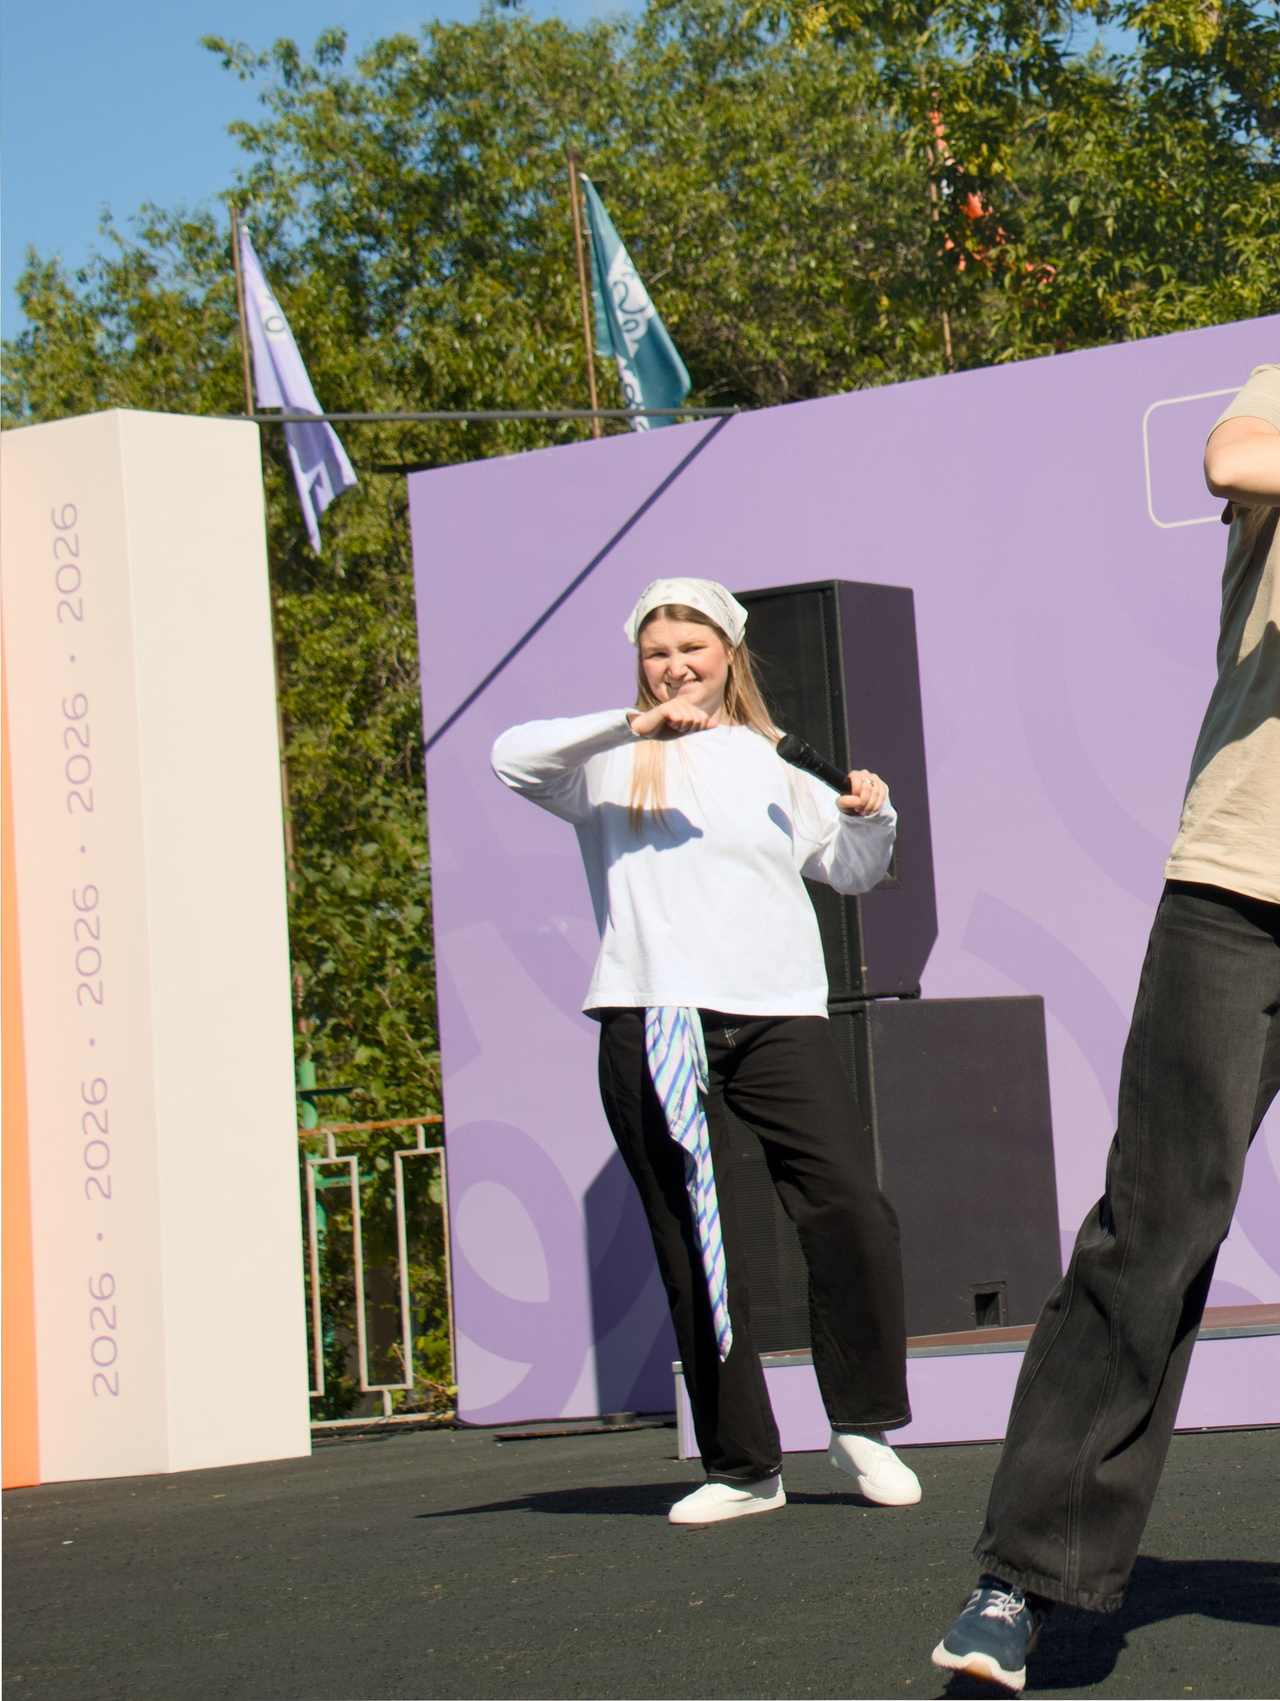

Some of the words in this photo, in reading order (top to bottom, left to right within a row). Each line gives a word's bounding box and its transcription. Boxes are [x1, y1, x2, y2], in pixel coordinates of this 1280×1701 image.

[51, 502, 84, 624] 2026
[62, 692, 95, 815] 2026
[72, 884, 104, 1007] 2026
[81, 1077, 112, 1201] 2026
[88, 1272, 120, 1398] 2026
